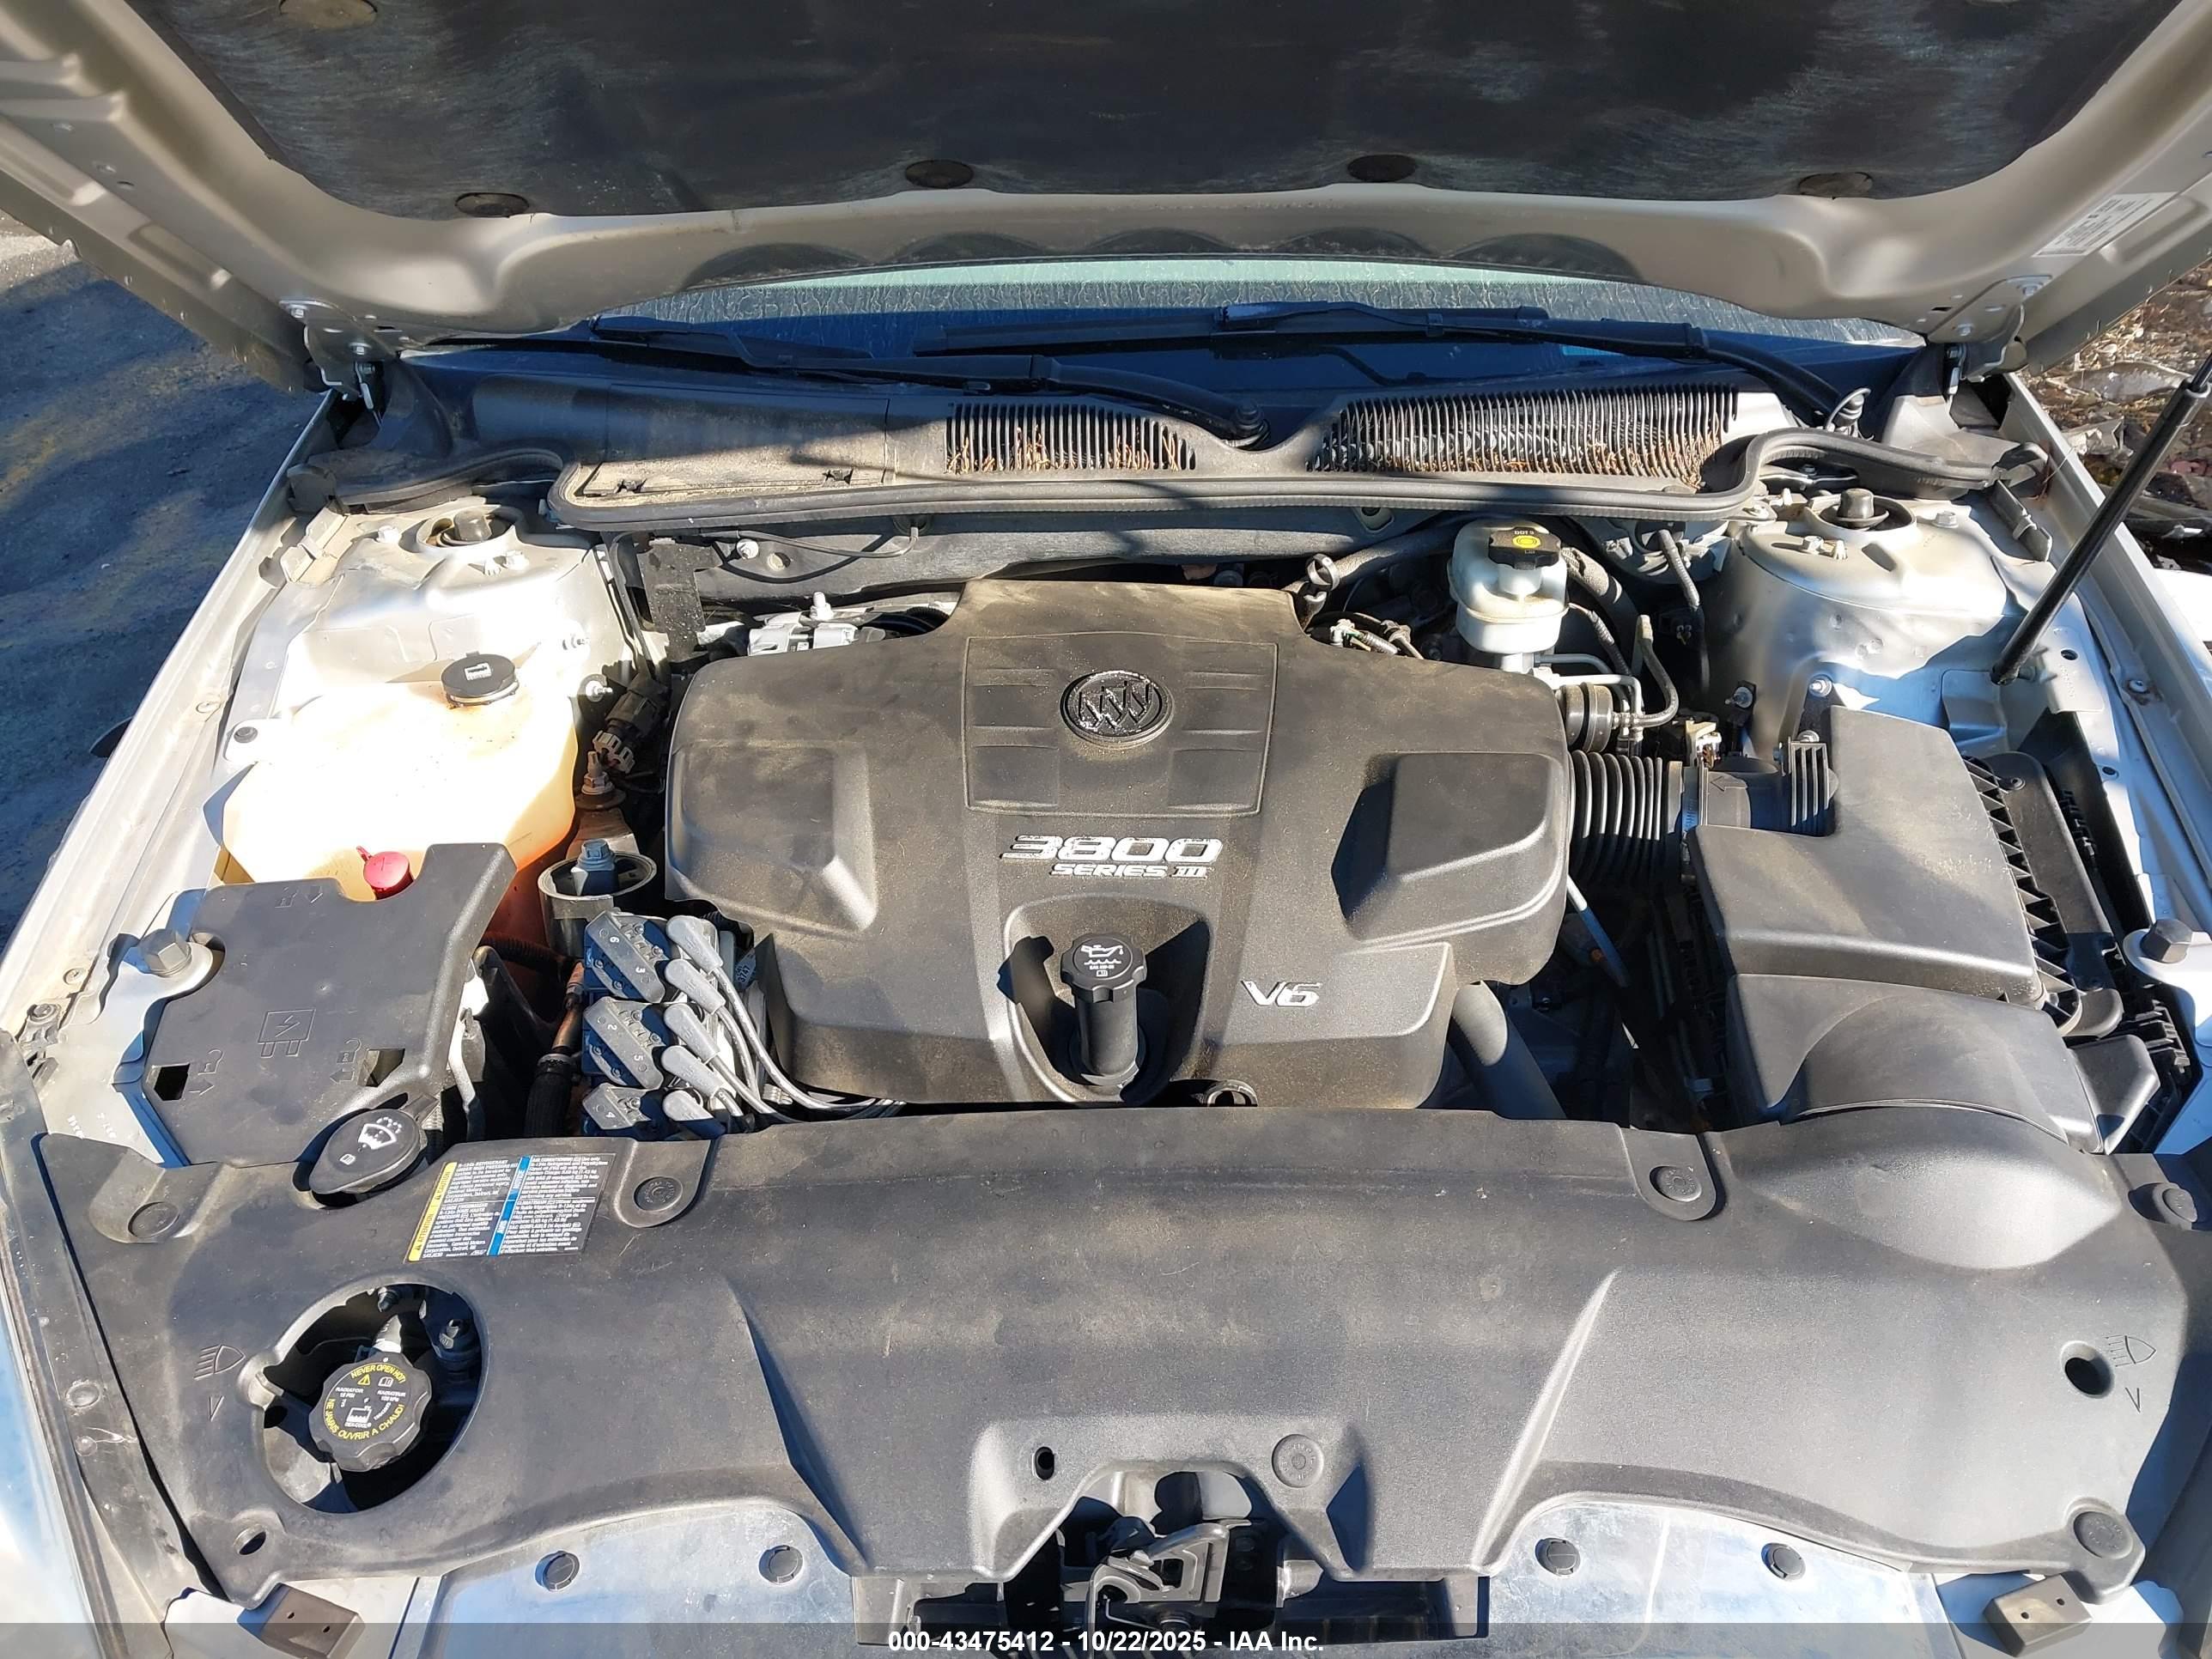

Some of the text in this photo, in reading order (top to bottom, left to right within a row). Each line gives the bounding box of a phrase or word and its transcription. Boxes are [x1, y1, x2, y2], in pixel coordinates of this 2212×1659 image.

[1000, 835, 1224, 865] 3800
[1049, 863, 1207, 878] SERIES III
[1241, 980, 1323, 1007] V6
[441, 1171, 451, 1189] CAUTION
[418, 1213, 434, 1243] ATTENTION
[350, 1365, 376, 1379] NEVER
[376, 1364, 396, 1374] OPEN
[326, 1399, 336, 1409] NE
[325, 1411, 339, 1433] JAMAIS
[338, 1430, 369, 1440] OUVRIR
